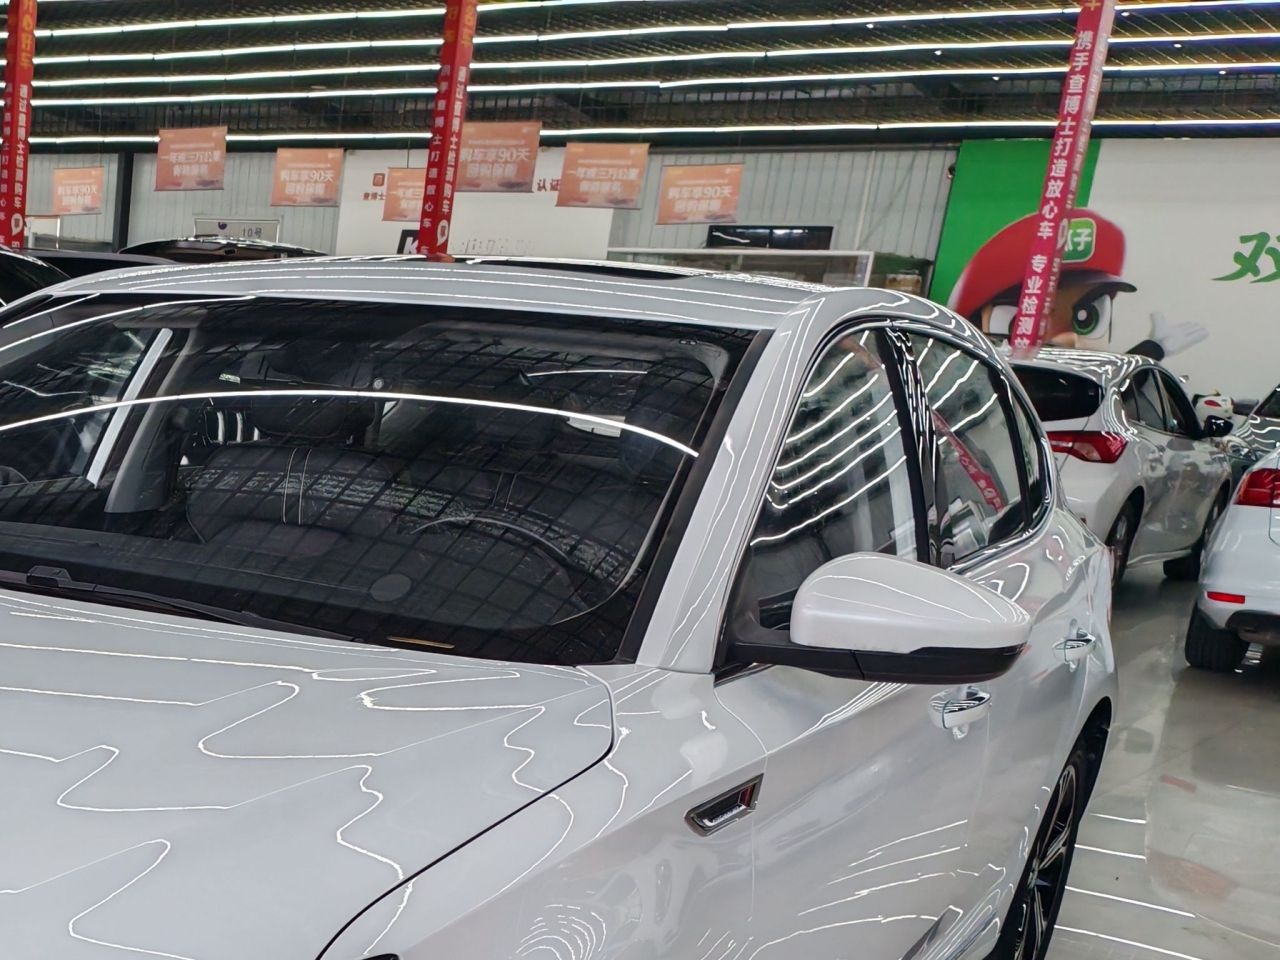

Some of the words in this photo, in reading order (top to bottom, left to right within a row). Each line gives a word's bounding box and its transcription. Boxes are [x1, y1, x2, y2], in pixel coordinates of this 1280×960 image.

[1037, 30, 1094, 240] 携手查博士打造放心车
